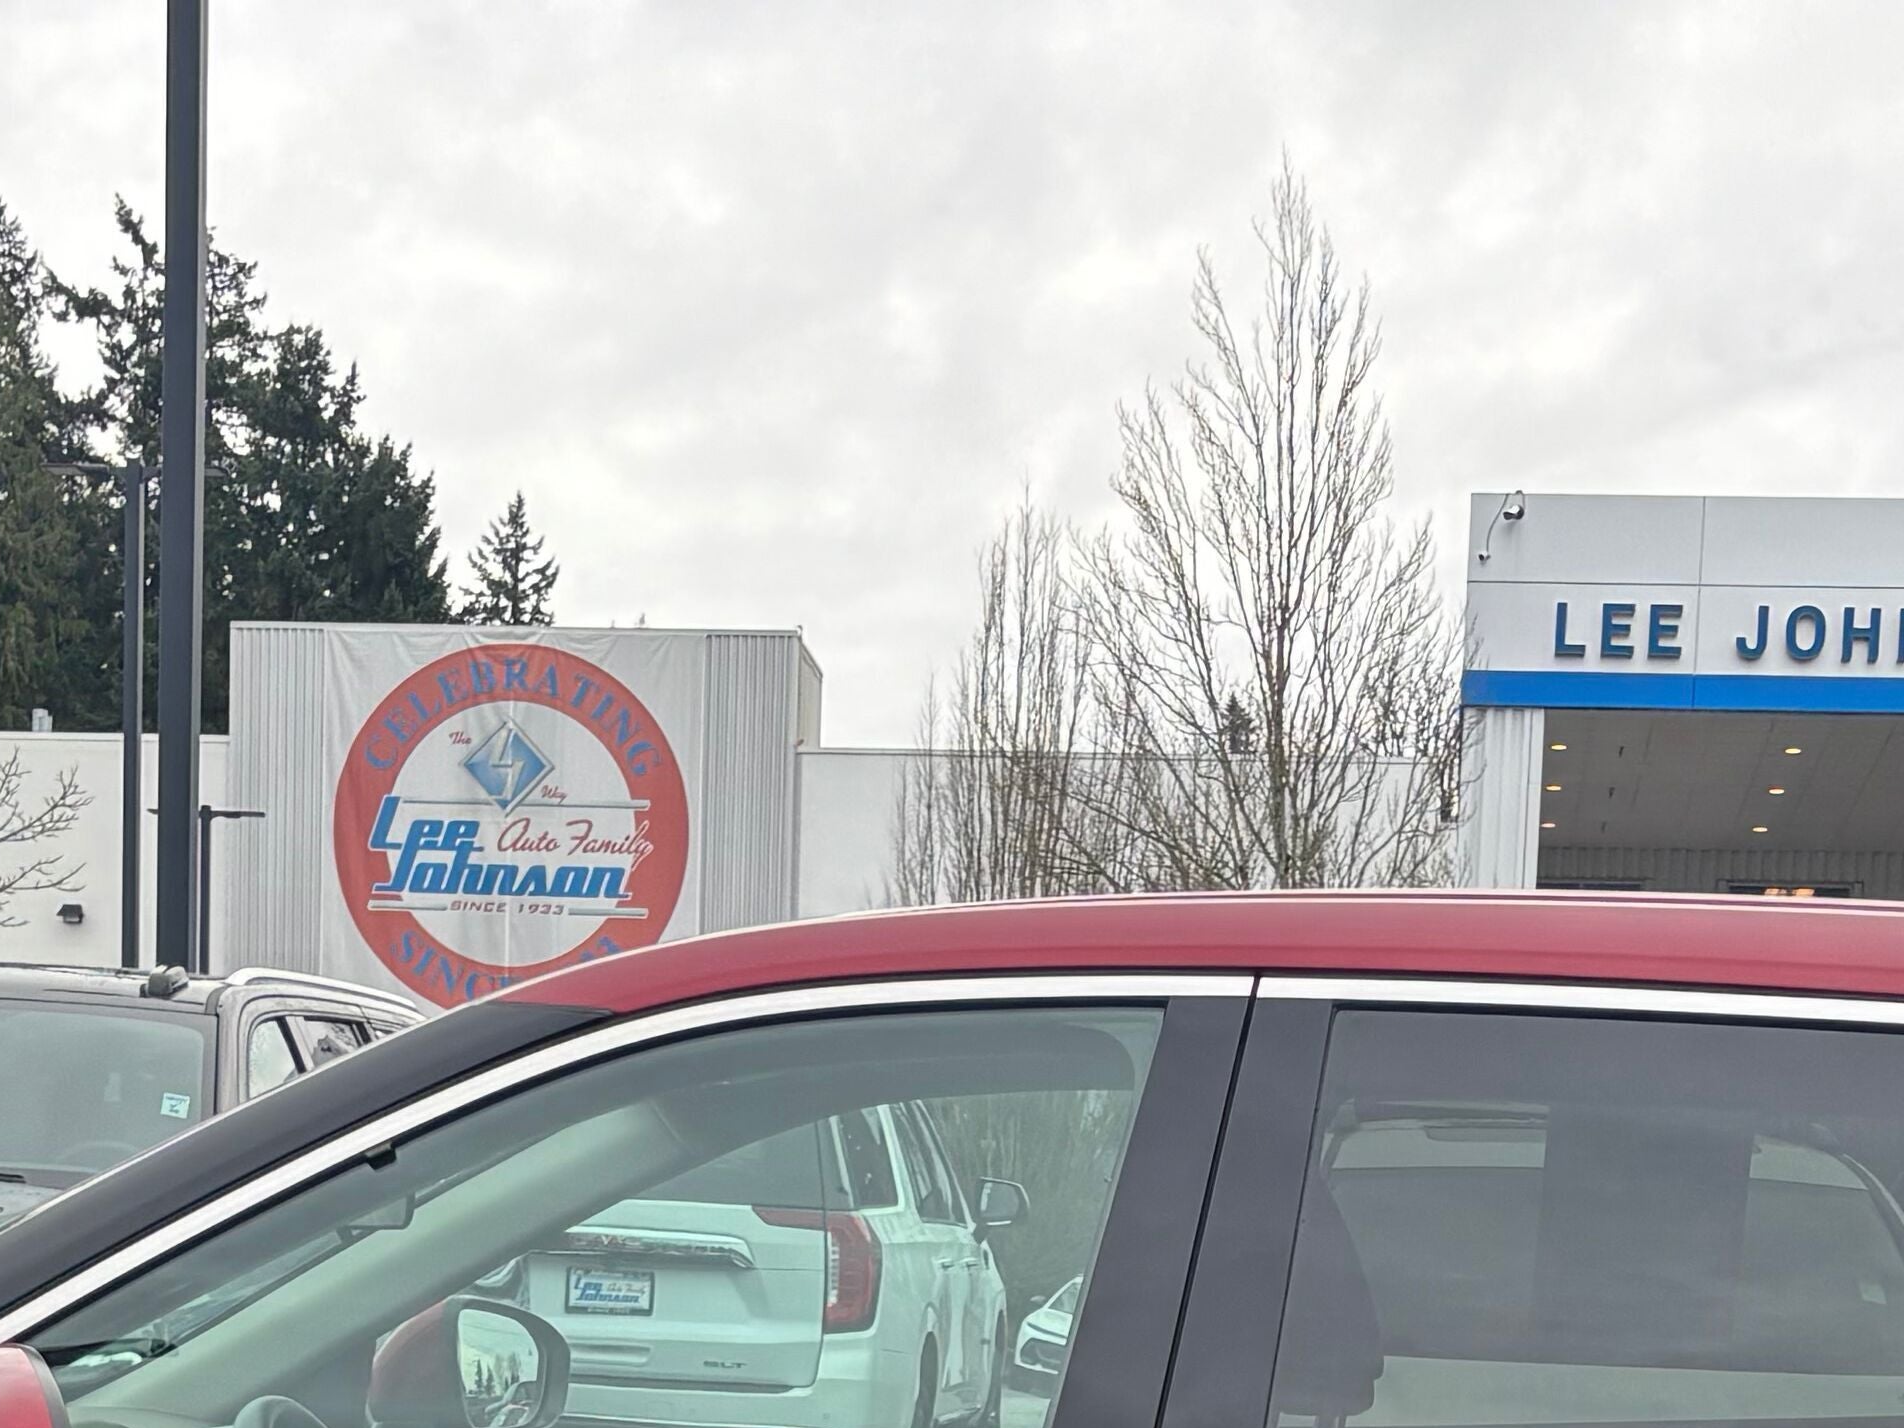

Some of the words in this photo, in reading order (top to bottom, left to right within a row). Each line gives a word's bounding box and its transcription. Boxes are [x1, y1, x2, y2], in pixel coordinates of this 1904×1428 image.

[1553, 602, 1684, 659] LEE
[364, 656, 664, 776] CELEBRATING
[448, 730, 473, 745] The
[541, 785, 568, 806] Way
[369, 795, 485, 852] Lee
[497, 817, 561, 852] Auto
[565, 818, 654, 871] Family
[374, 836, 629, 899] Johnson
[450, 900, 506, 913] SINCE
[517, 902, 565, 916] 1933
